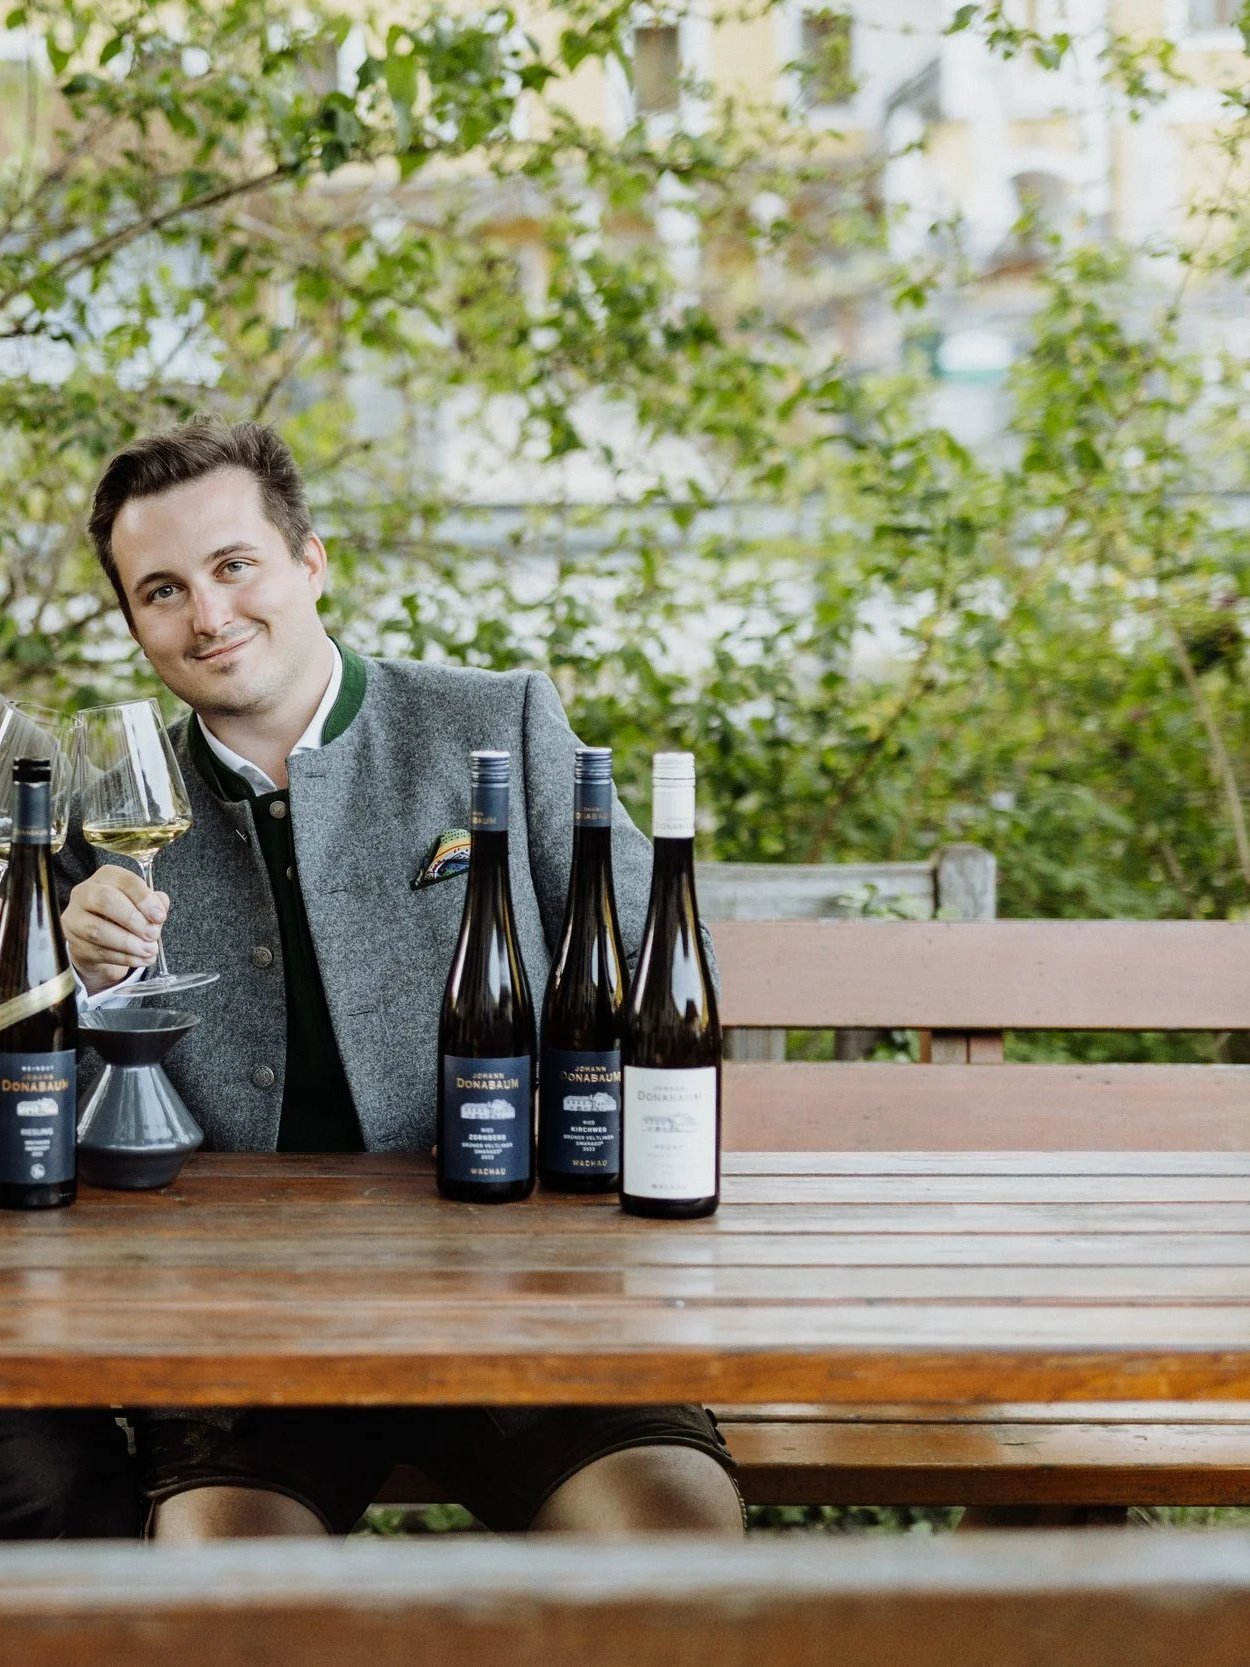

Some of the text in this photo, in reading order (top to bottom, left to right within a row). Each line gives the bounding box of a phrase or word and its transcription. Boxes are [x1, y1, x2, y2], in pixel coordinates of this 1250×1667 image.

[472, 1072, 505, 1080] JOHANN
[561, 1071, 621, 1082] DONABAUM
[1, 1079, 69, 1092] DONABAUM
[456, 1077, 519, 1090] DONABAUM
[468, 1133, 507, 1141] ZORNBERG
[470, 1167, 507, 1176] WACHAU
